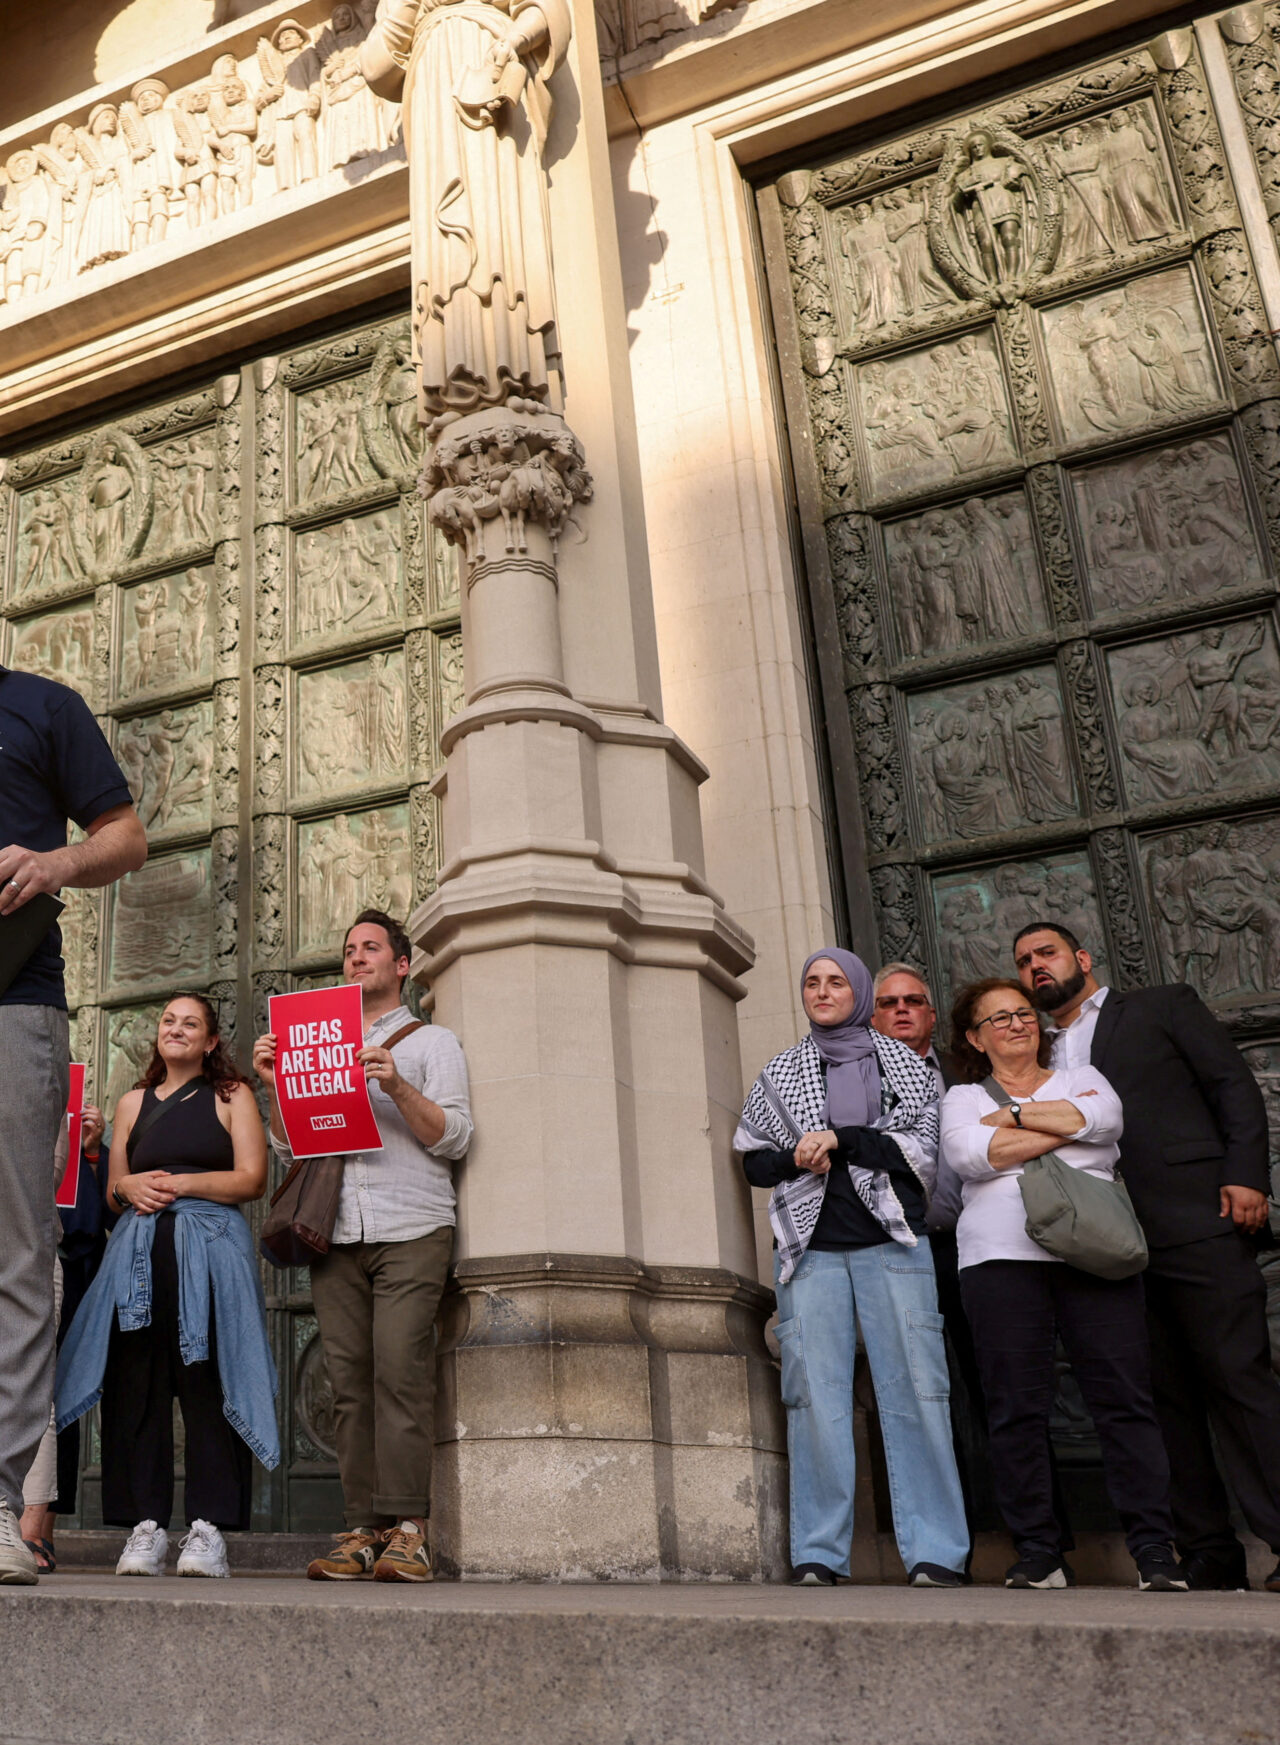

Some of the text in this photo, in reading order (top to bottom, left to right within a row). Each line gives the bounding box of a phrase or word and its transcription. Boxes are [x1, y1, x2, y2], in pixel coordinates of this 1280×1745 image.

[288, 1018, 343, 1048] IDEAS
[281, 1043, 356, 1075] ARE NOT
[285, 1069, 357, 1100] ILLEGAL
[311, 1115, 345, 1130] NYCLU
